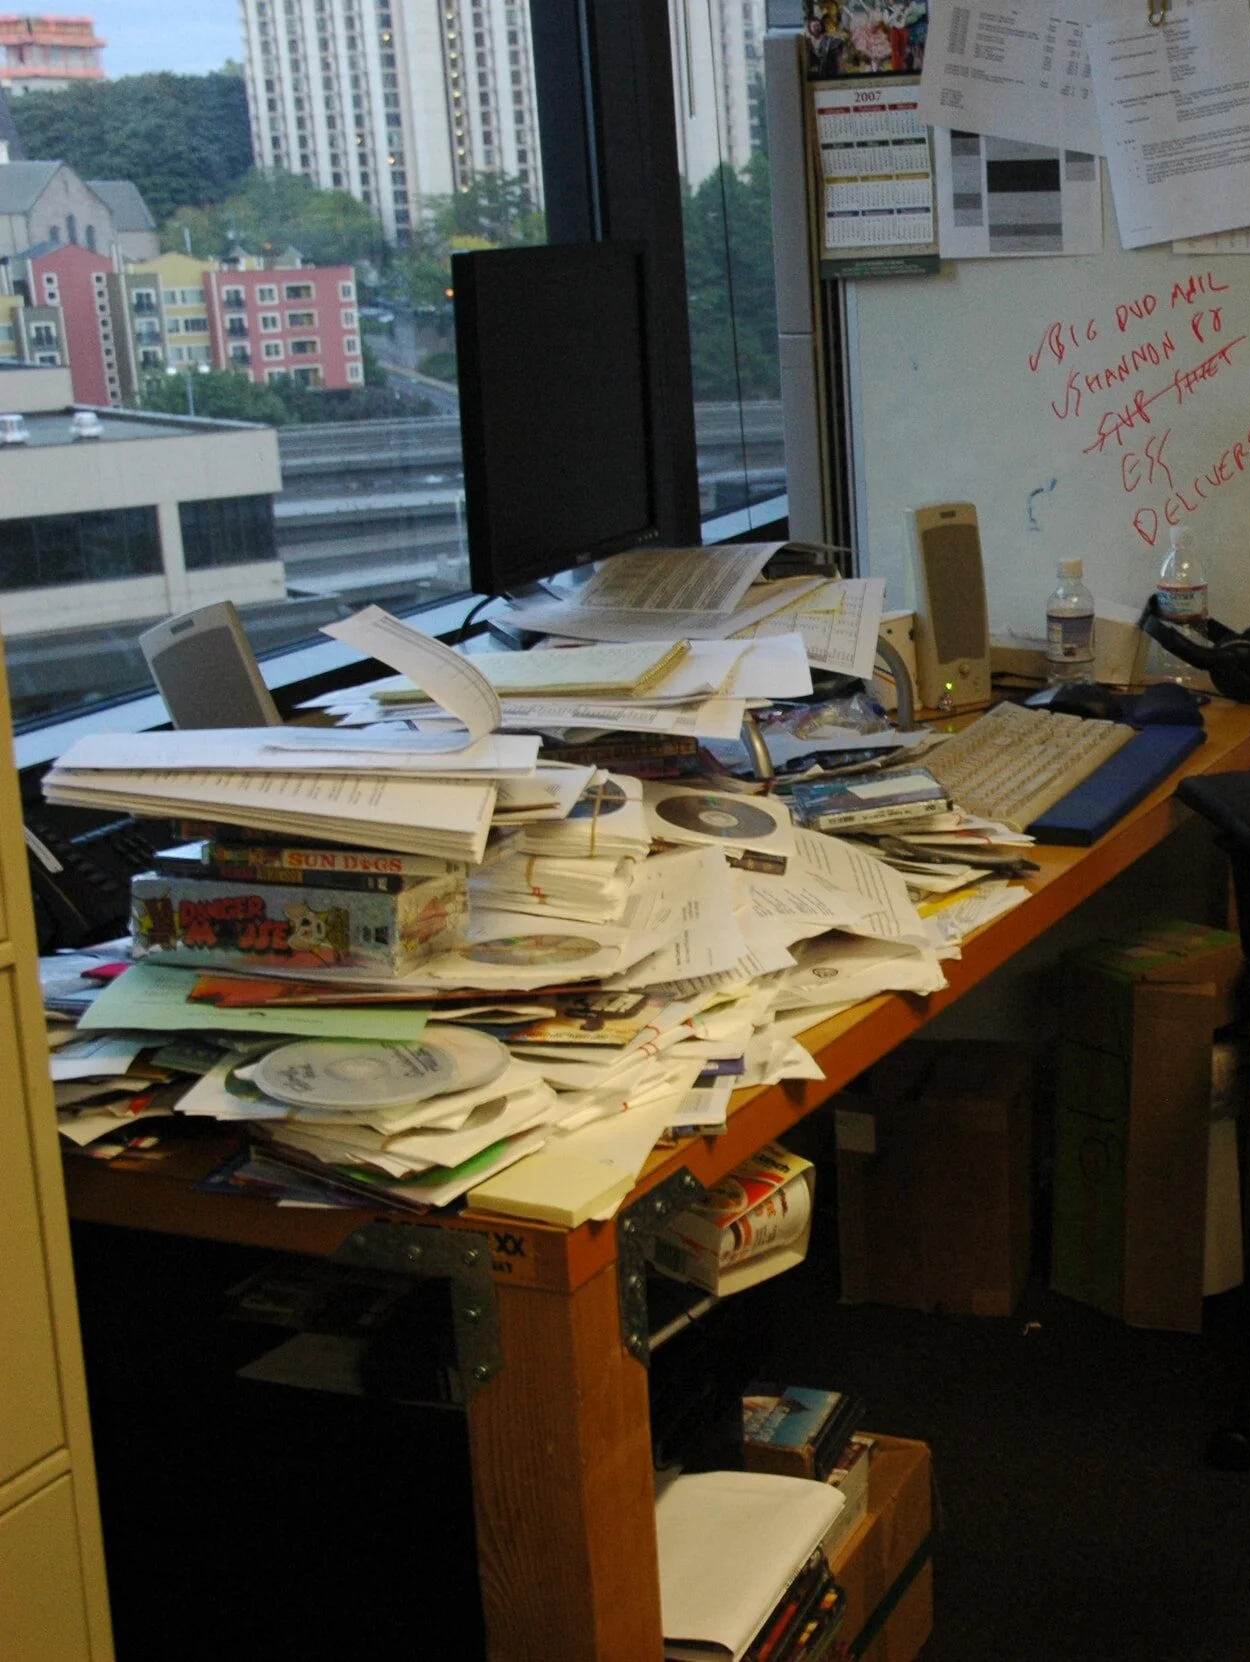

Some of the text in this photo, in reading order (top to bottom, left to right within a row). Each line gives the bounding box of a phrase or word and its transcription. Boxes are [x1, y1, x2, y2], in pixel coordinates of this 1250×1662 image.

[853, 90, 883, 104] 2007
[1116, 294, 1157, 333] DVD
[288, 851, 336, 869] SUN
[180, 894, 266, 928] DANGER
